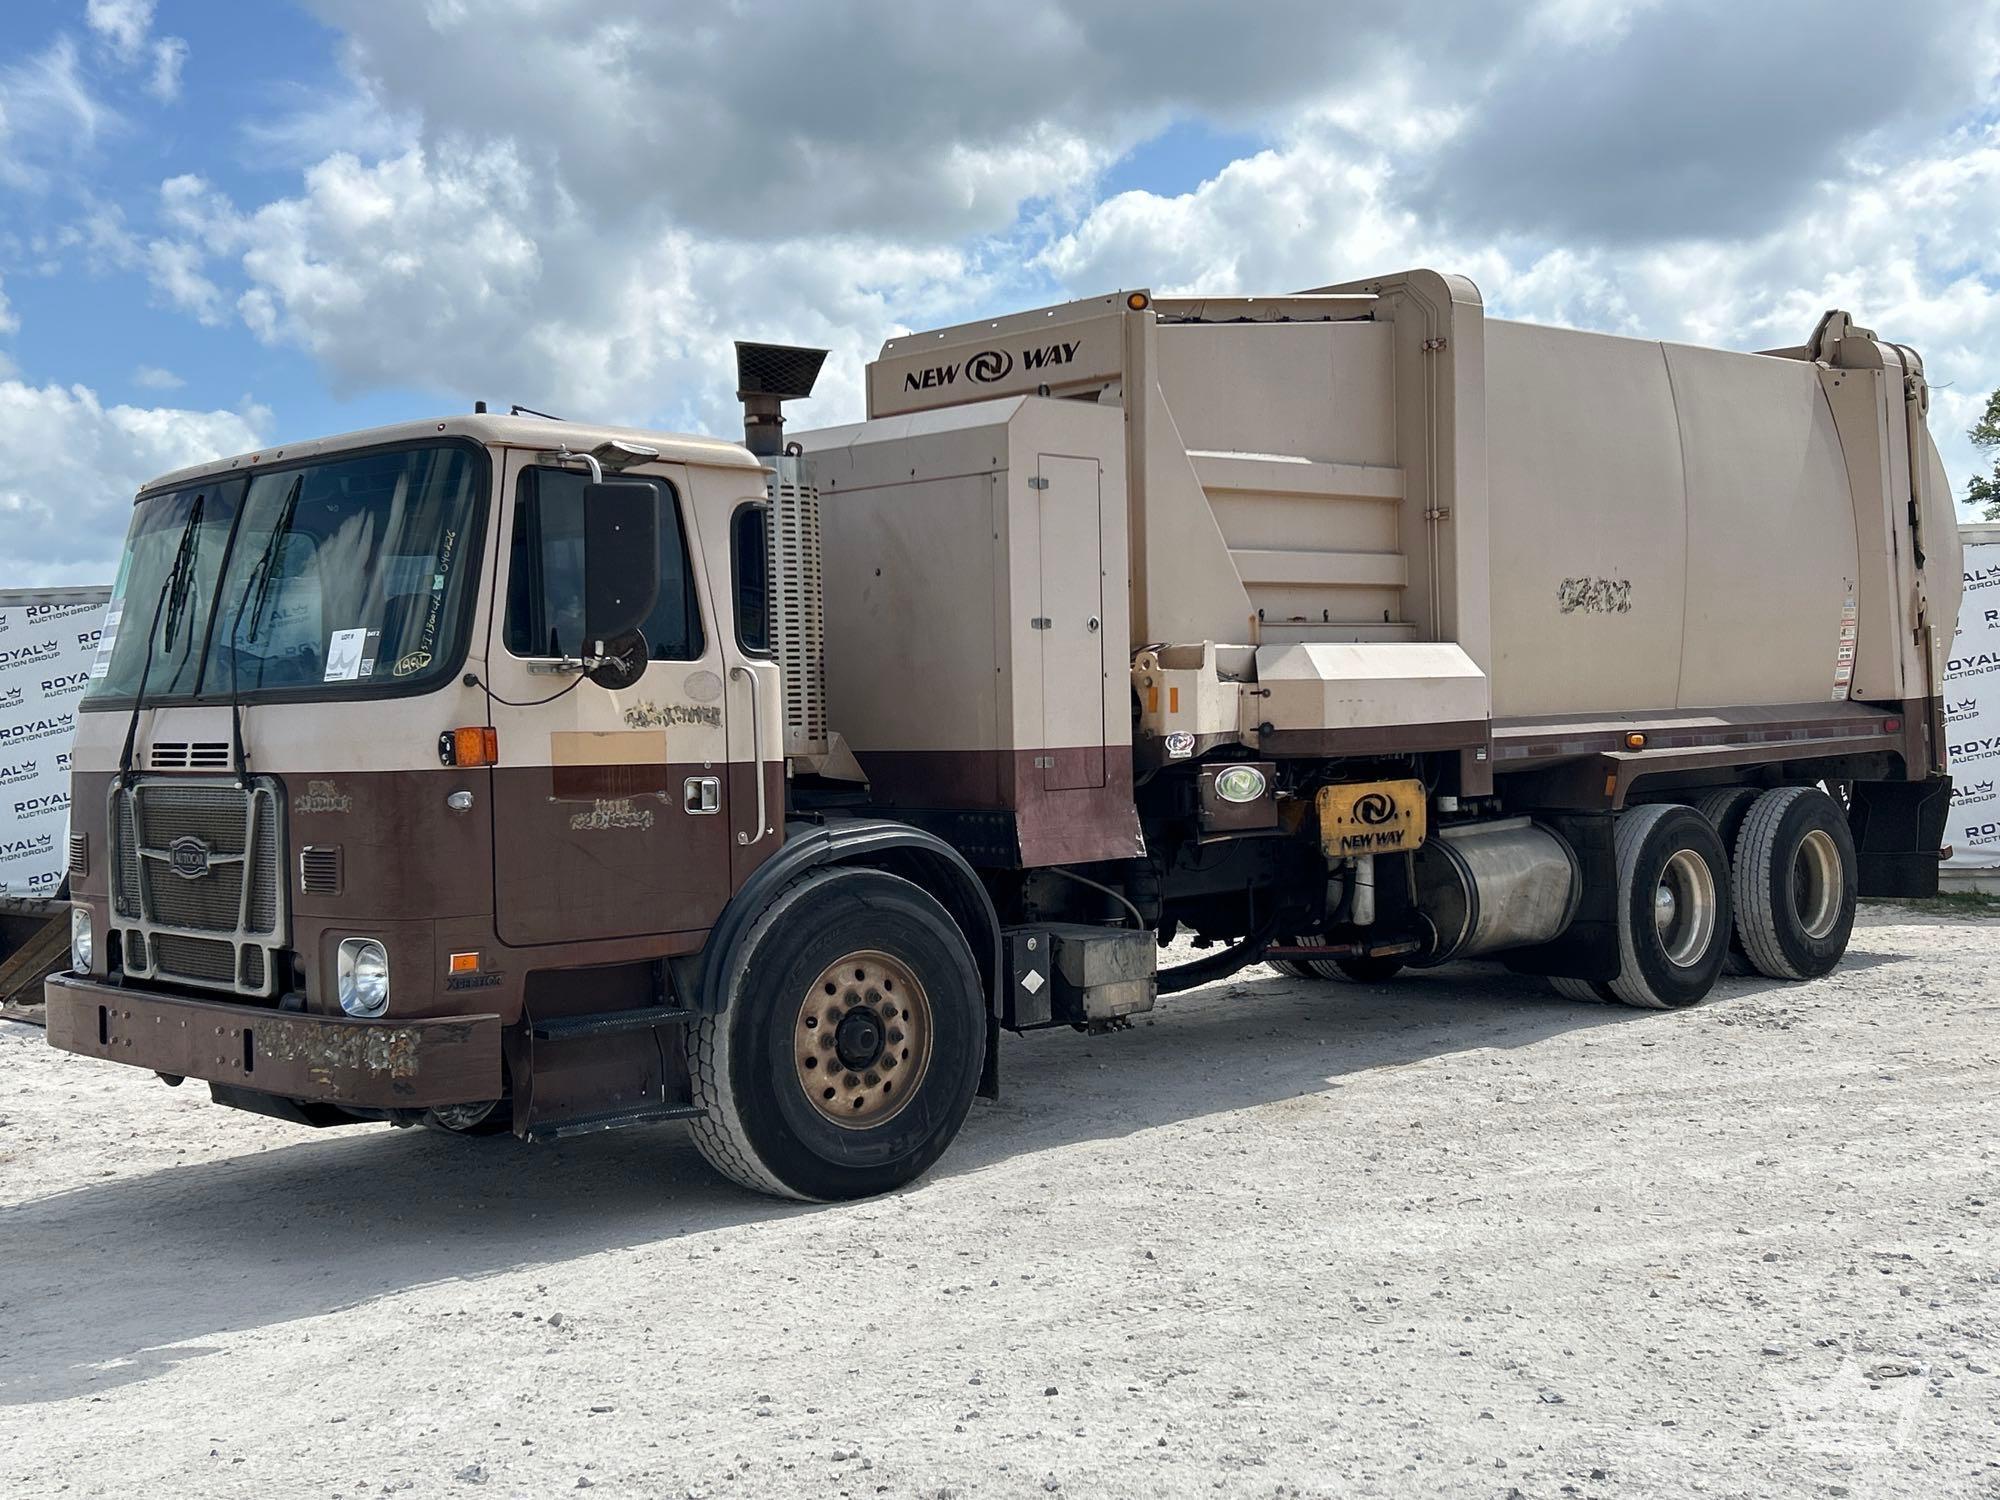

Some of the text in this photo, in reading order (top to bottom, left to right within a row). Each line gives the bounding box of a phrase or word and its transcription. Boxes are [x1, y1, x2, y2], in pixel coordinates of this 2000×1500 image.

[904, 363, 961, 392] NEW
[1023, 340, 1081, 370] WAY
[26, 604, 75, 618] ROY
[29, 611, 69, 625] AUCTION
[28, 651, 60, 664] GROUP
[44, 684, 85, 698] AUCTION
[0, 719, 58, 739] ROYAL
[2, 725, 75, 747] AUCTION GROUP
[7, 771, 39, 784] GROUP
[14, 792, 71, 813] ROYAL
[1957, 793, 1997, 806] GROUP
[17, 806, 57, 820] AUCTION
[1341, 829, 1405, 850] NEW WAY
[0, 839, 37, 855] YAL
[22, 845, 53, 858] GROUP
